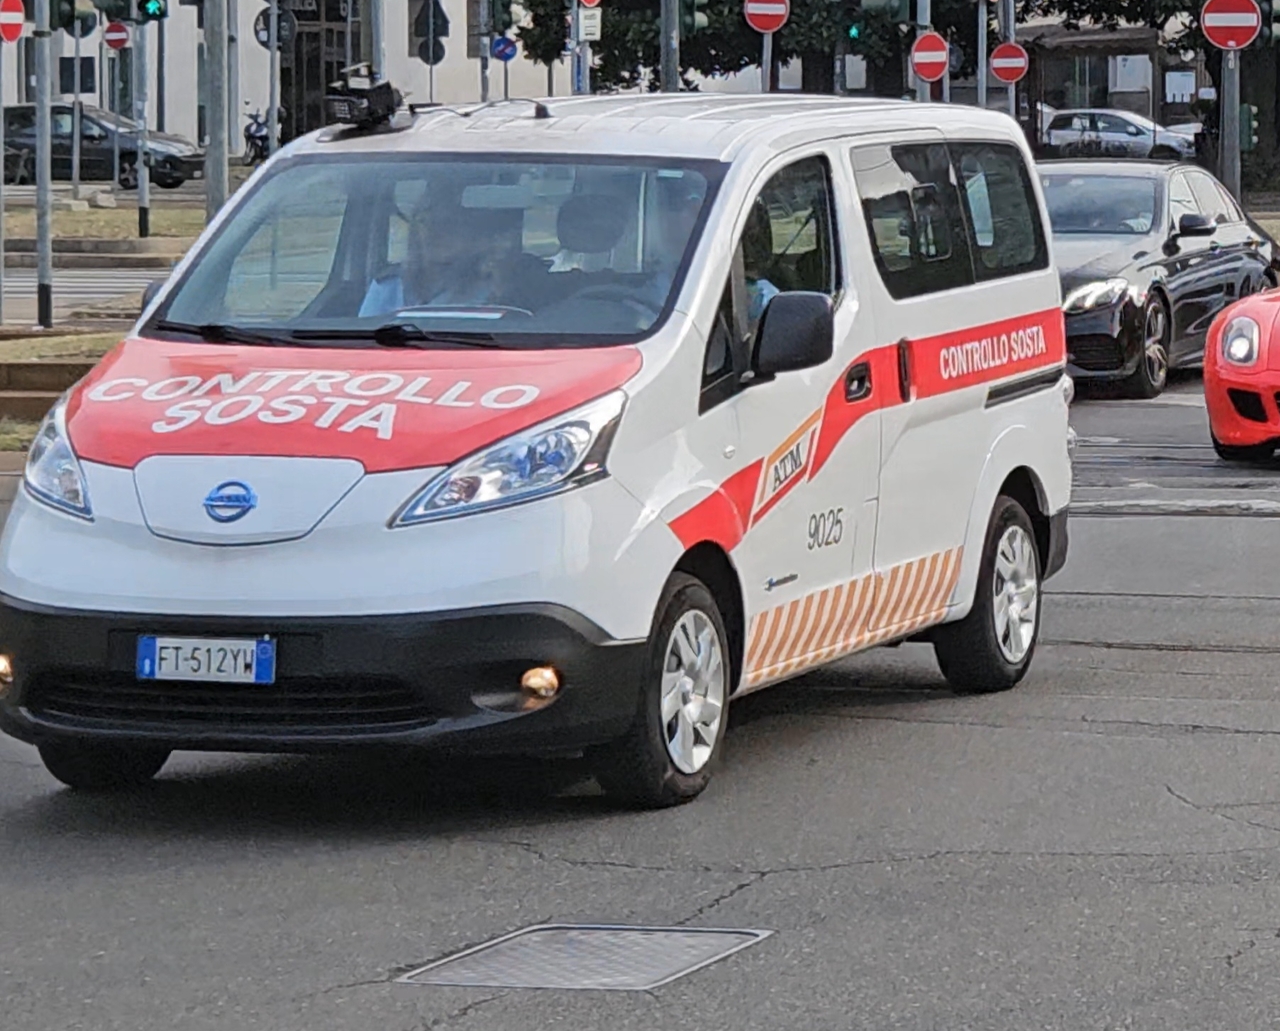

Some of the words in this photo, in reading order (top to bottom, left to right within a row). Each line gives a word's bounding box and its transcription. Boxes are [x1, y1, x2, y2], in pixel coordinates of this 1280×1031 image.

[939, 334, 1009, 380] CONTROLLO
[1010, 325, 1047, 361] SOSTA
[88, 369, 541, 410] CONTROLLO
[151, 394, 398, 441] SOSTA
[772, 442, 803, 493] ATM
[807, 507, 844, 550] 9025
